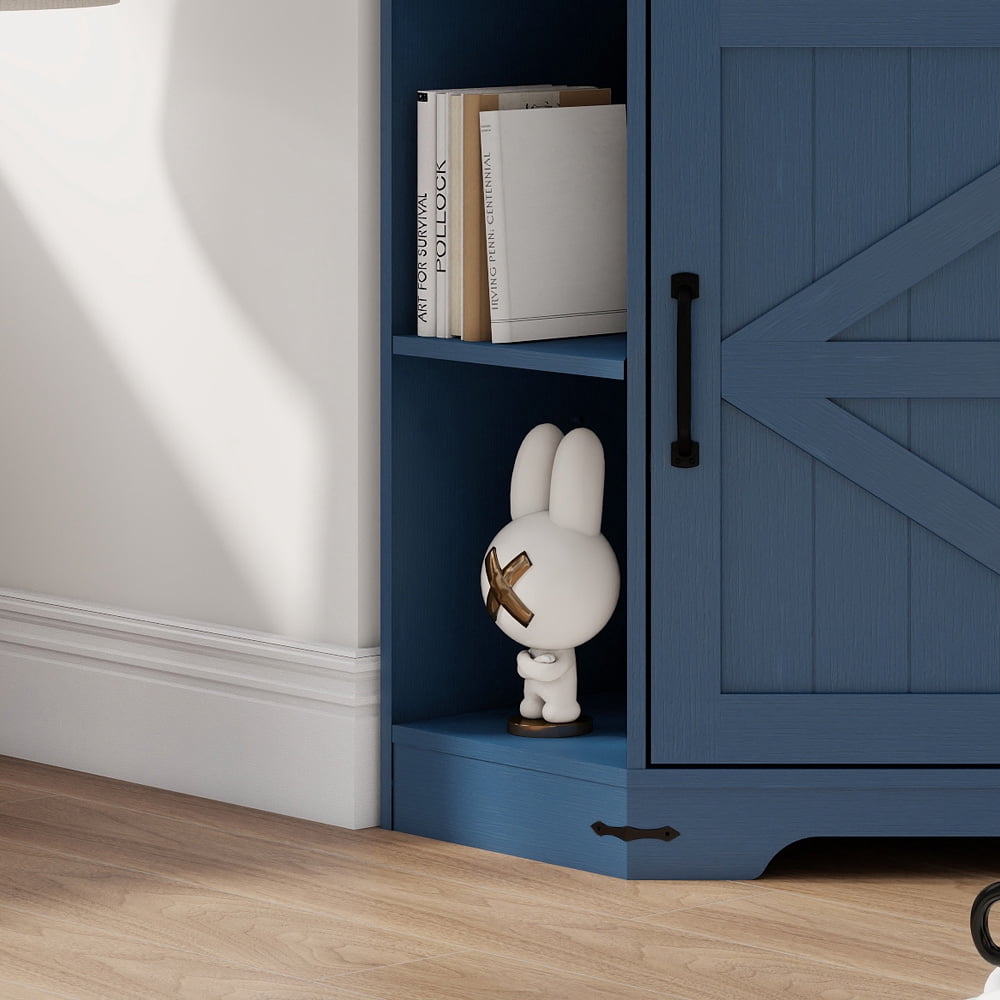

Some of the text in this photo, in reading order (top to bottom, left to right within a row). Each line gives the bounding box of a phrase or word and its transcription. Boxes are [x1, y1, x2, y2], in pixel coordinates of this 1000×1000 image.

[435, 159, 447, 273] POLLOCK
[483, 151, 495, 225] CENTENNIAL
[417, 192, 428, 323] ART FOR SURVIVAL
[489, 266, 499, 310] IRVING
